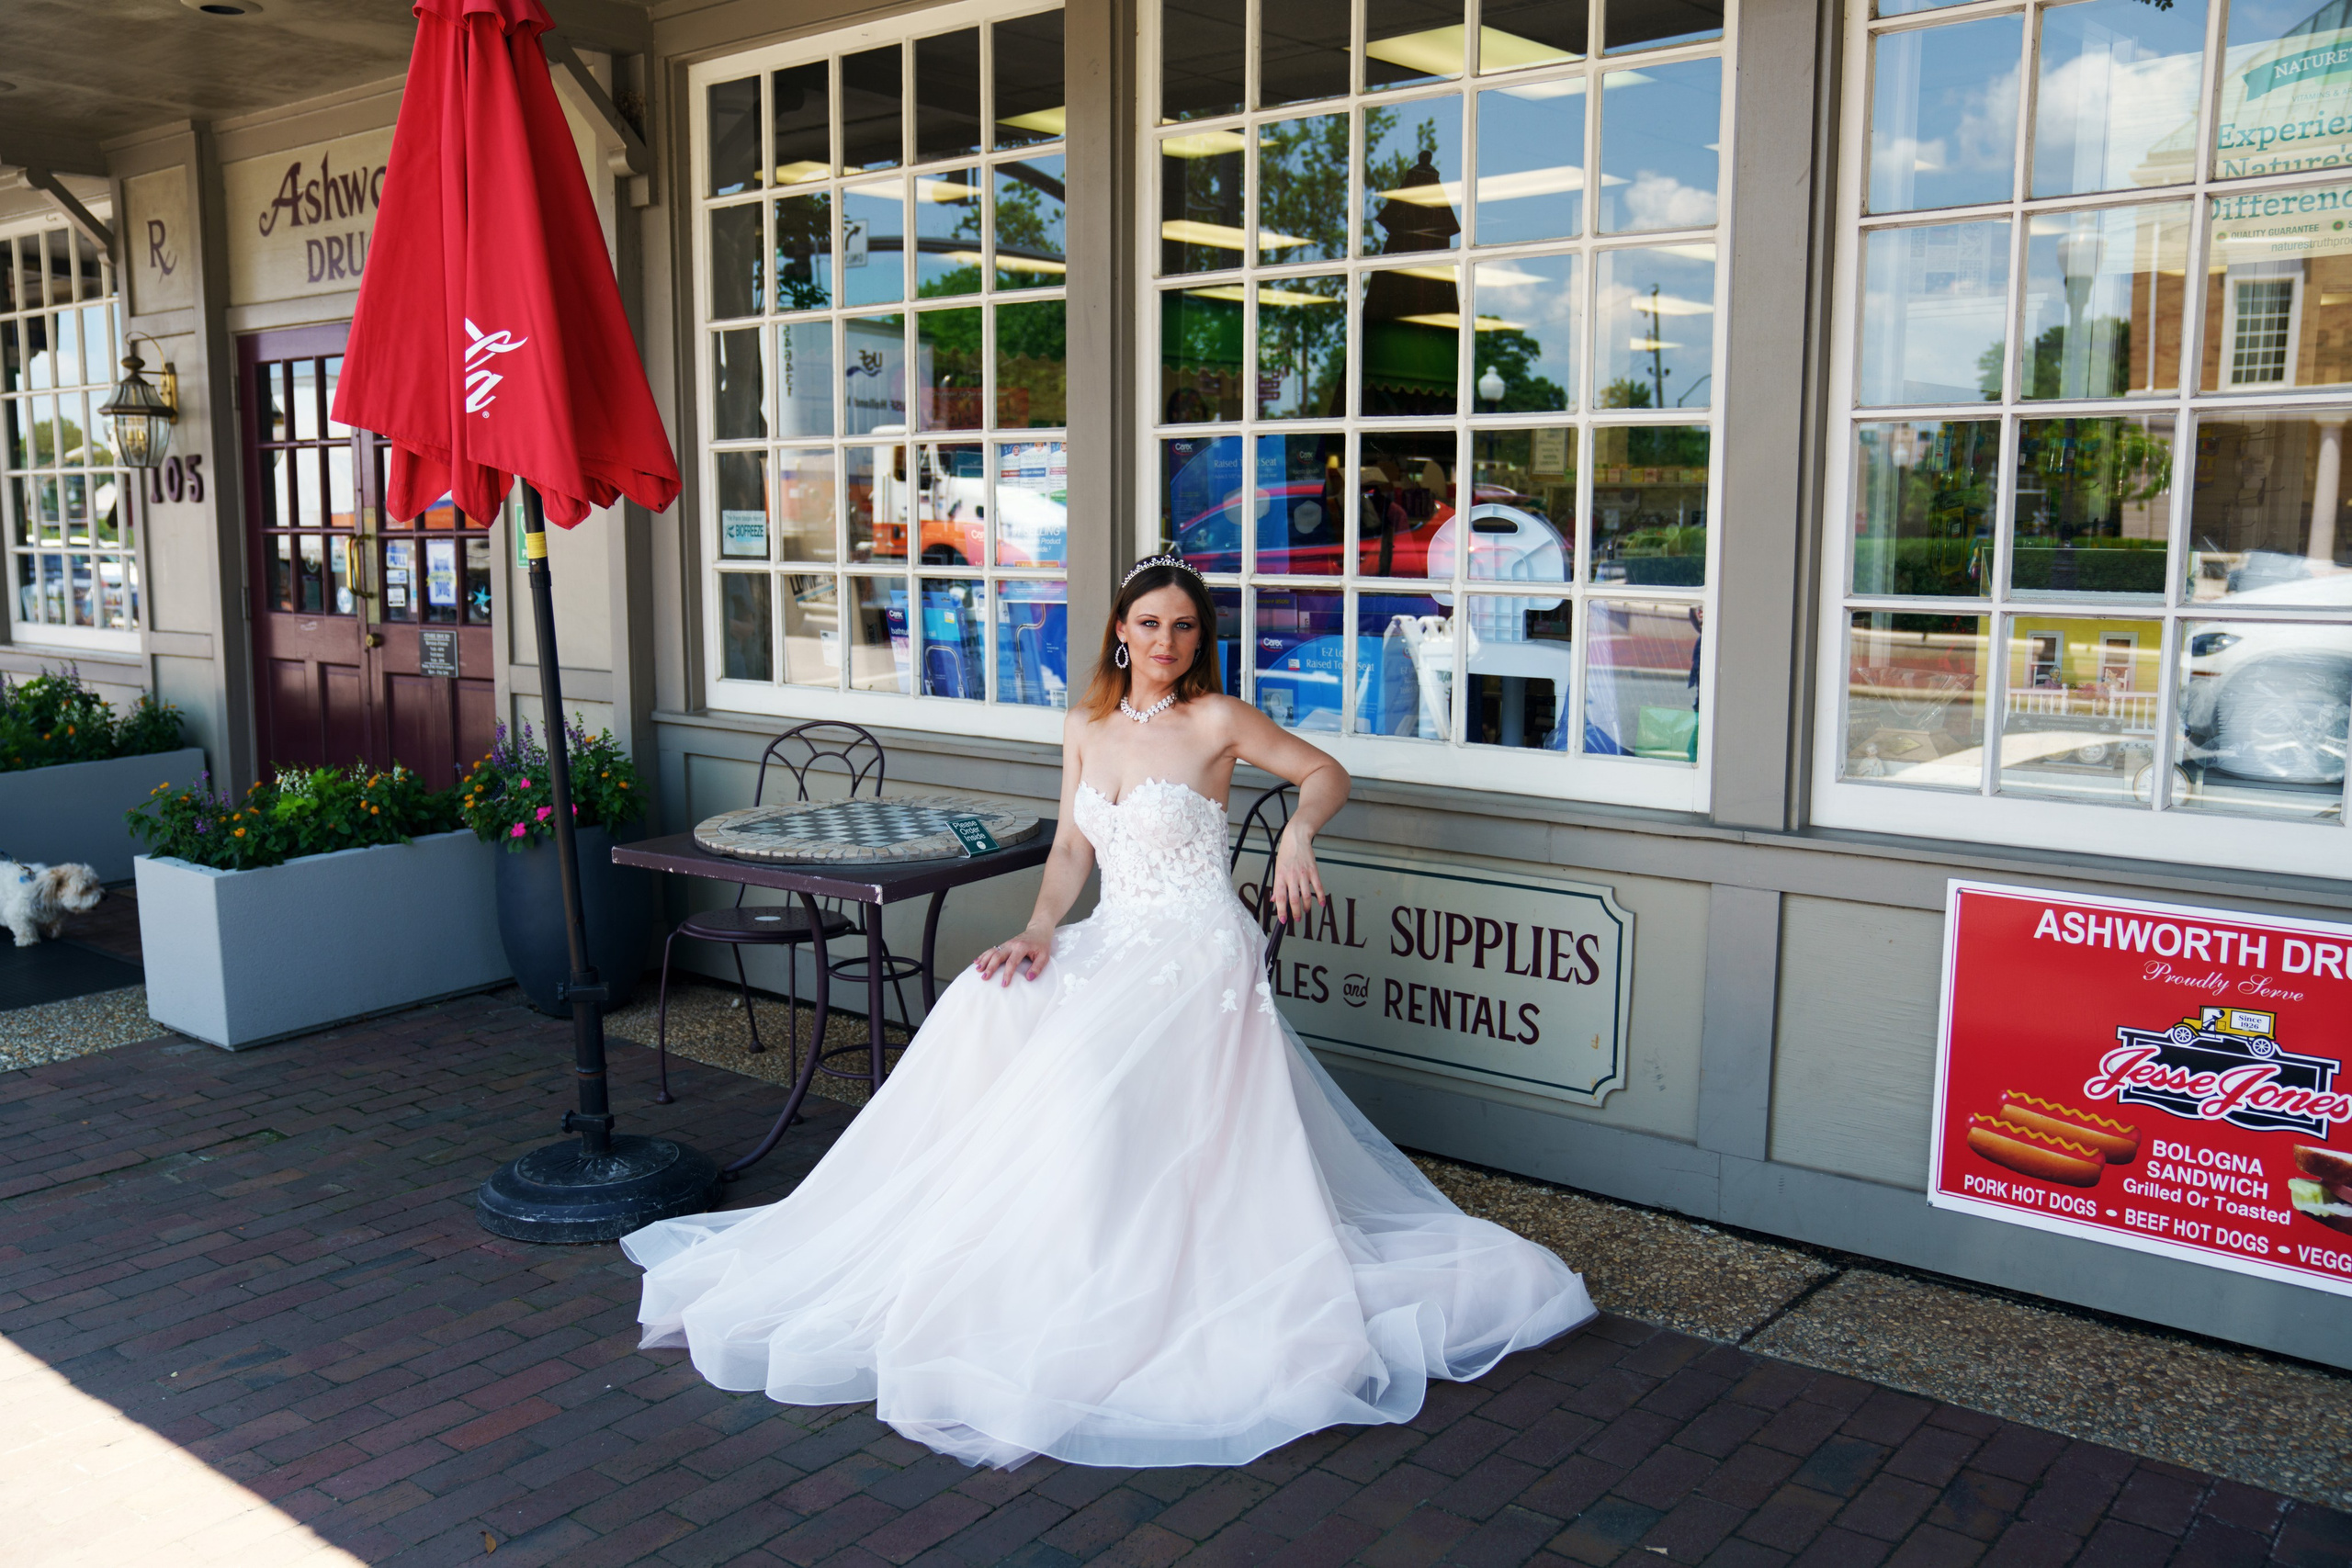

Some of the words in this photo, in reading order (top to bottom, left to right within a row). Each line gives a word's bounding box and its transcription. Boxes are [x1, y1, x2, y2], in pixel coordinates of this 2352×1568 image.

[2291, 90, 2331, 102] VITAMINS
[2217, 110, 2352, 152] Experie
[2231, 230, 2267, 240] QUALITY
[2267, 223, 2320, 236] GUARANTEE
[306, 231, 373, 283] DRU
[1214, 459, 1238, 468] Raised
[1261, 458, 1277, 467] Seat
[150, 454, 204, 503] 105
[736, 525, 763, 537] BIOFREEZE
[1263, 637, 1283, 647] Carex
[1321, 648, 1333, 657] E-Z
[1335, 649, 1343, 657] Lo
[1306, 659, 1331, 669] Raised
[1357, 661, 1374, 671] Seat
[953, 820, 978, 829] Please
[960, 827, 980, 835] Order
[964, 833, 986, 842] Inside
[1390, 905, 1600, 986] SUPPLIES
[2033, 908, 2267, 969] ASHWORTH
[2143, 960, 2229, 997] Proudly
[2237, 974, 2304, 1002] Serve
[1343, 976, 1371, 999] and
[1384, 978, 1541, 1046] RENTALS
[2238, 1014, 2263, 1024] Since
[2240, 1021, 2260, 1030] 1926
[2083, 1044, 2218, 1100] Jesse
[2198, 1063, 2352, 1123] Jones
[2152, 1139, 2264, 1177] BOLOGNA
[2146, 1161, 2268, 1200] SANDWICH
[2122, 1178, 2182, 1203] Grilled
[2186, 1190, 2211, 1209] Or
[2213, 1196, 2290, 1225] Toasted
[1963, 1175, 2007, 1199] PORK
[2011, 1184, 2046, 1208] HOT
[2049, 1192, 2097, 1218] DOGS
[2124, 1209, 2169, 1233] BEEF
[2174, 1219, 2212, 1242] HOT
[2216, 1228, 2269, 1254] DOGS
[2297, 1244, 2352, 1273] VEGG
